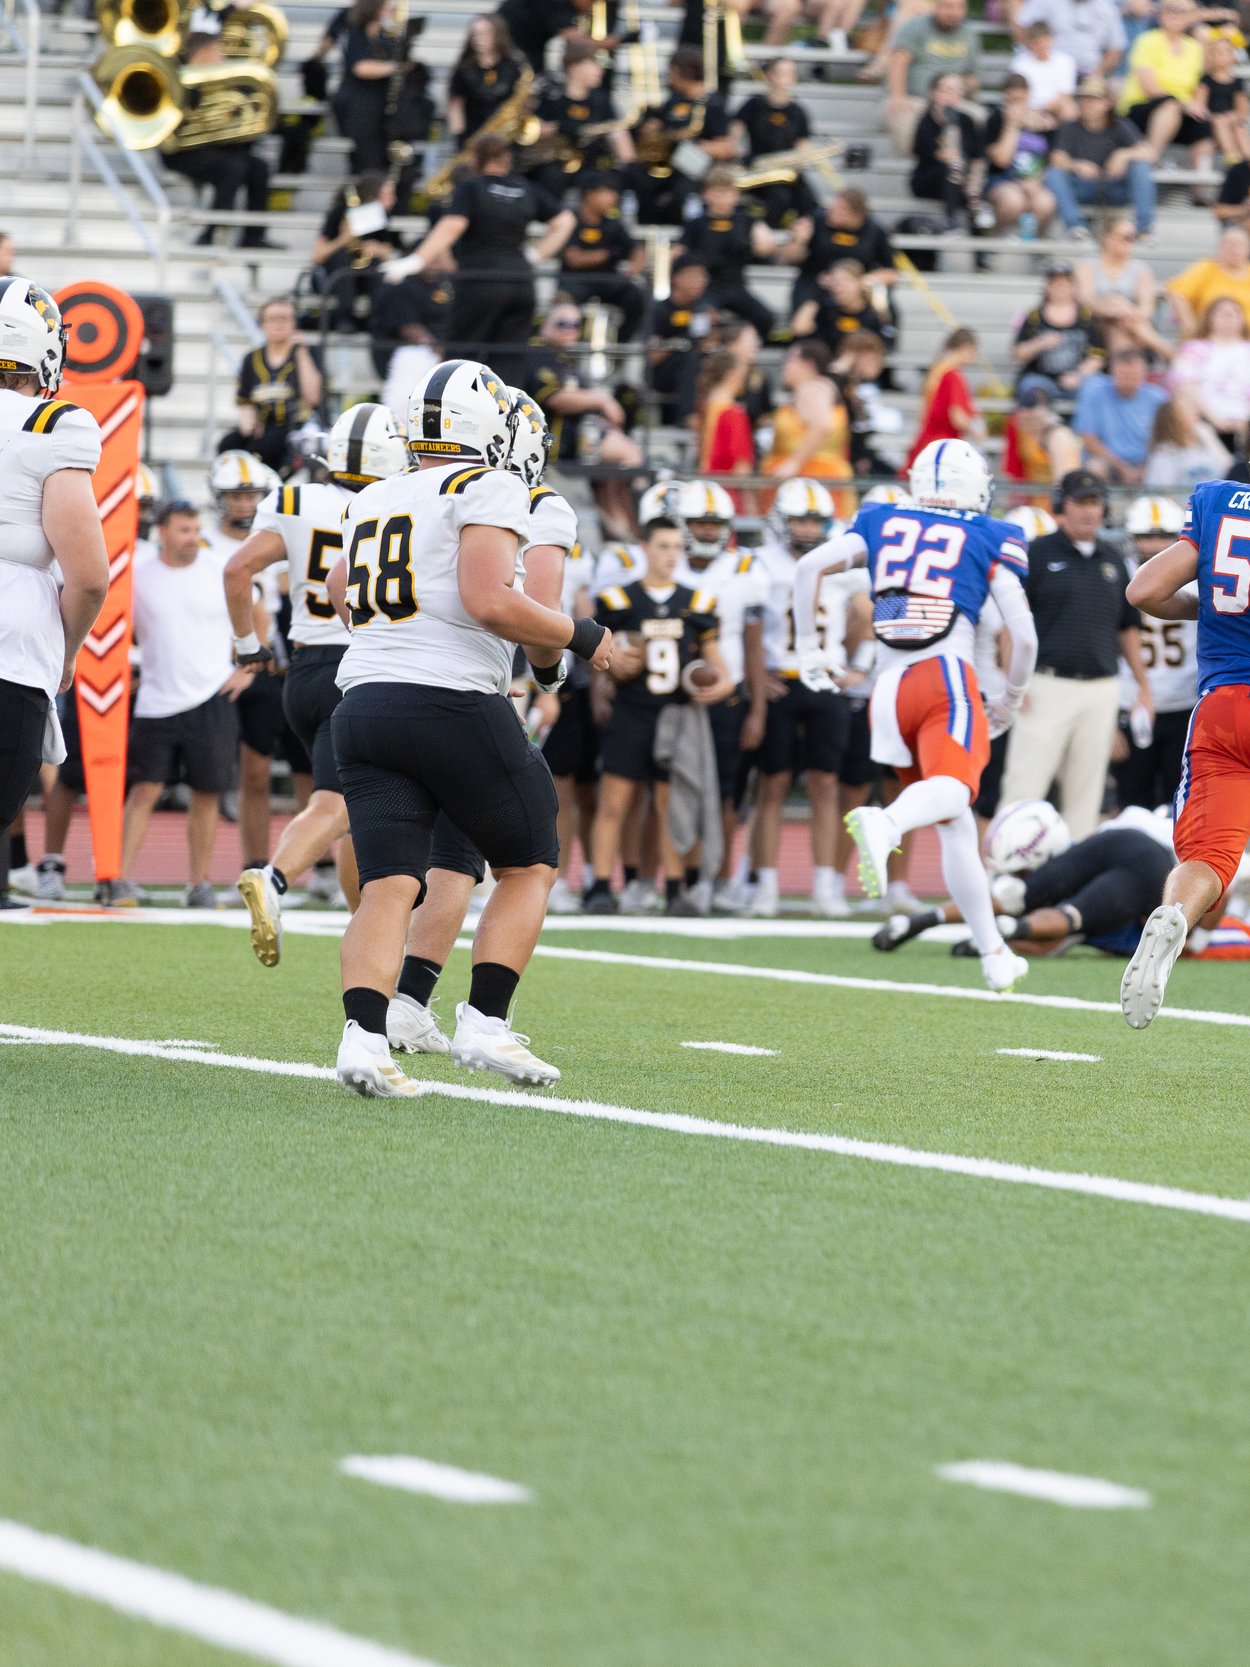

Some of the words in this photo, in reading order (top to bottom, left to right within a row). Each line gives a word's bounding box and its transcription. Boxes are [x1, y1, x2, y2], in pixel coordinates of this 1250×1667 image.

[411, 442, 461, 452] MOUNTAINEERS
[344, 513, 421, 628] 58
[874, 516, 967, 599] 22
[646, 639, 680, 695] 9
